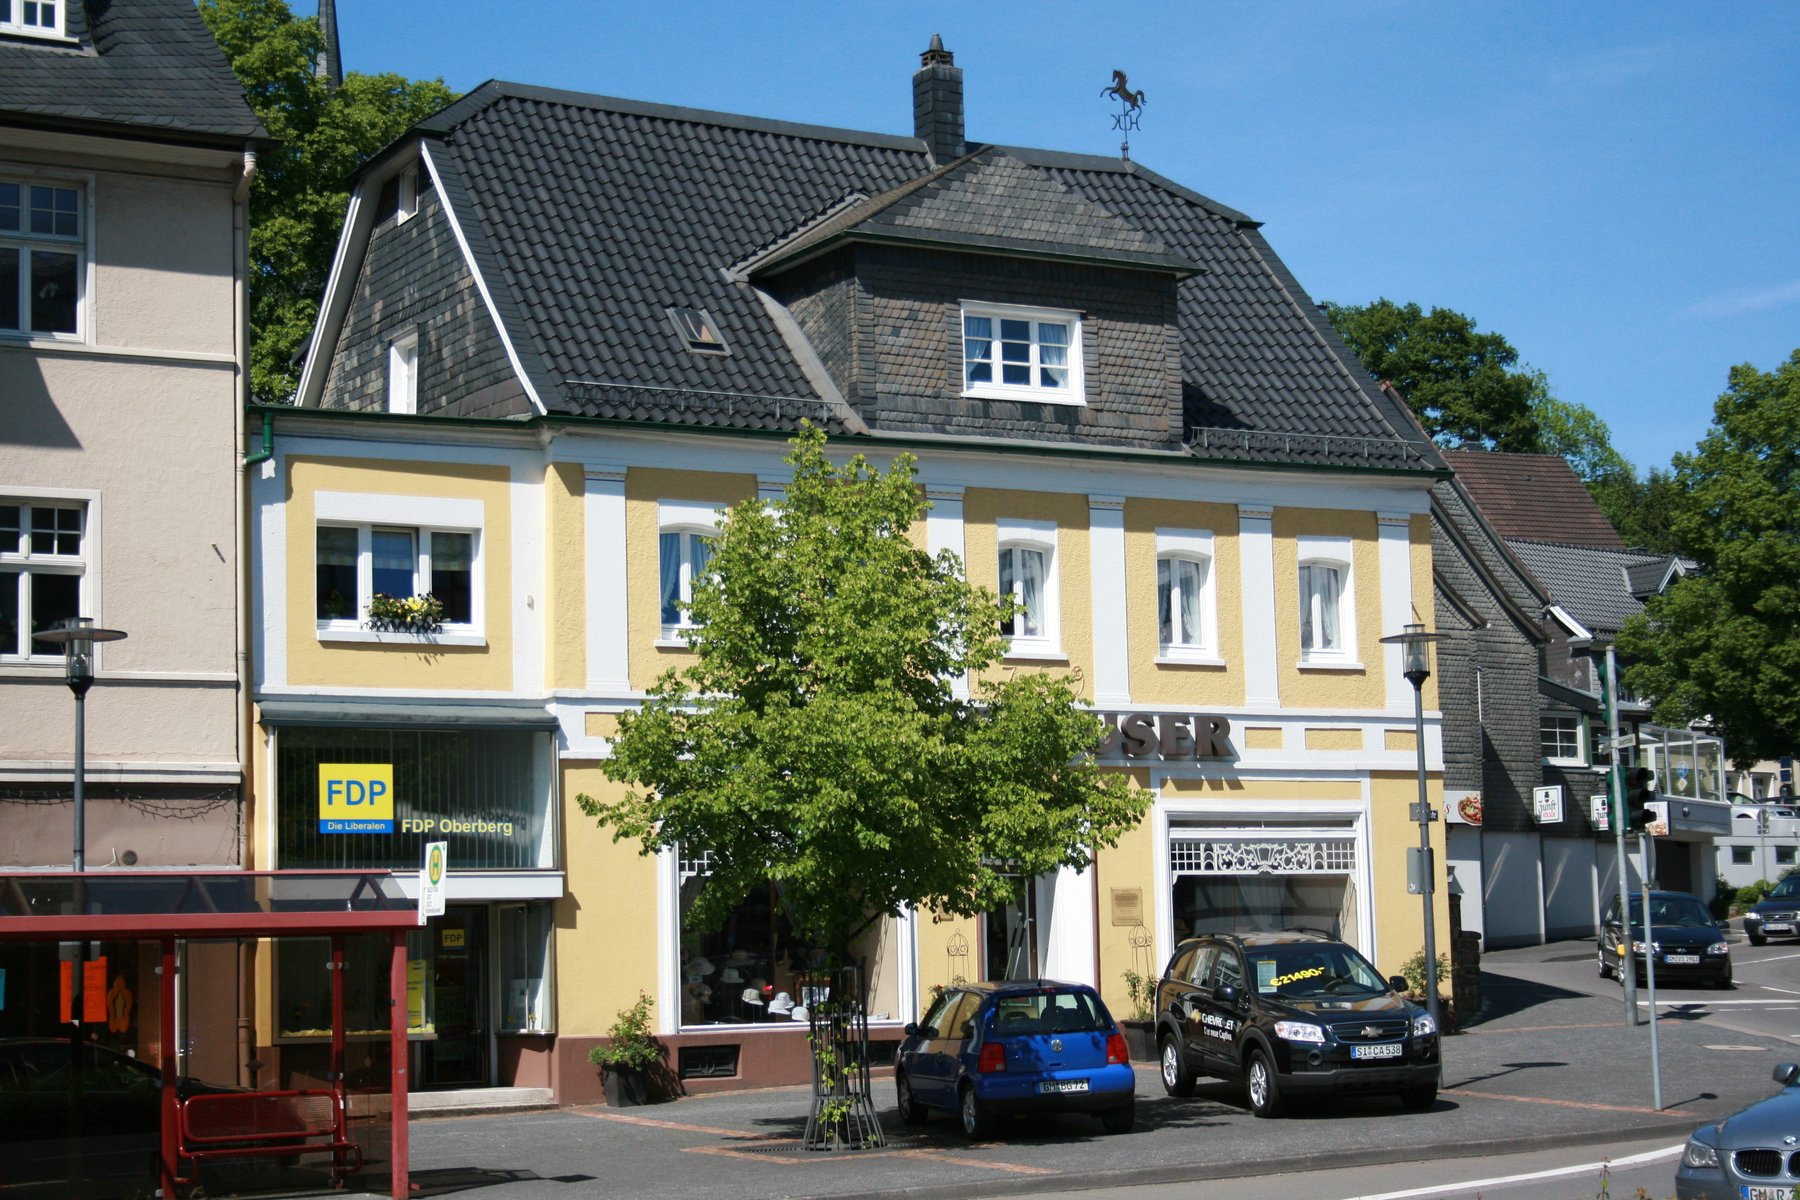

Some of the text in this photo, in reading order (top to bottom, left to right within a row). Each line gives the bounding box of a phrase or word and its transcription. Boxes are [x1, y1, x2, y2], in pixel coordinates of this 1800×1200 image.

[327, 780, 387, 805] FDP
[327, 821, 386, 830] Die Liberalen
[401, 818, 514, 836] FDP Oberberg
[445, 934, 463, 943] FDP
